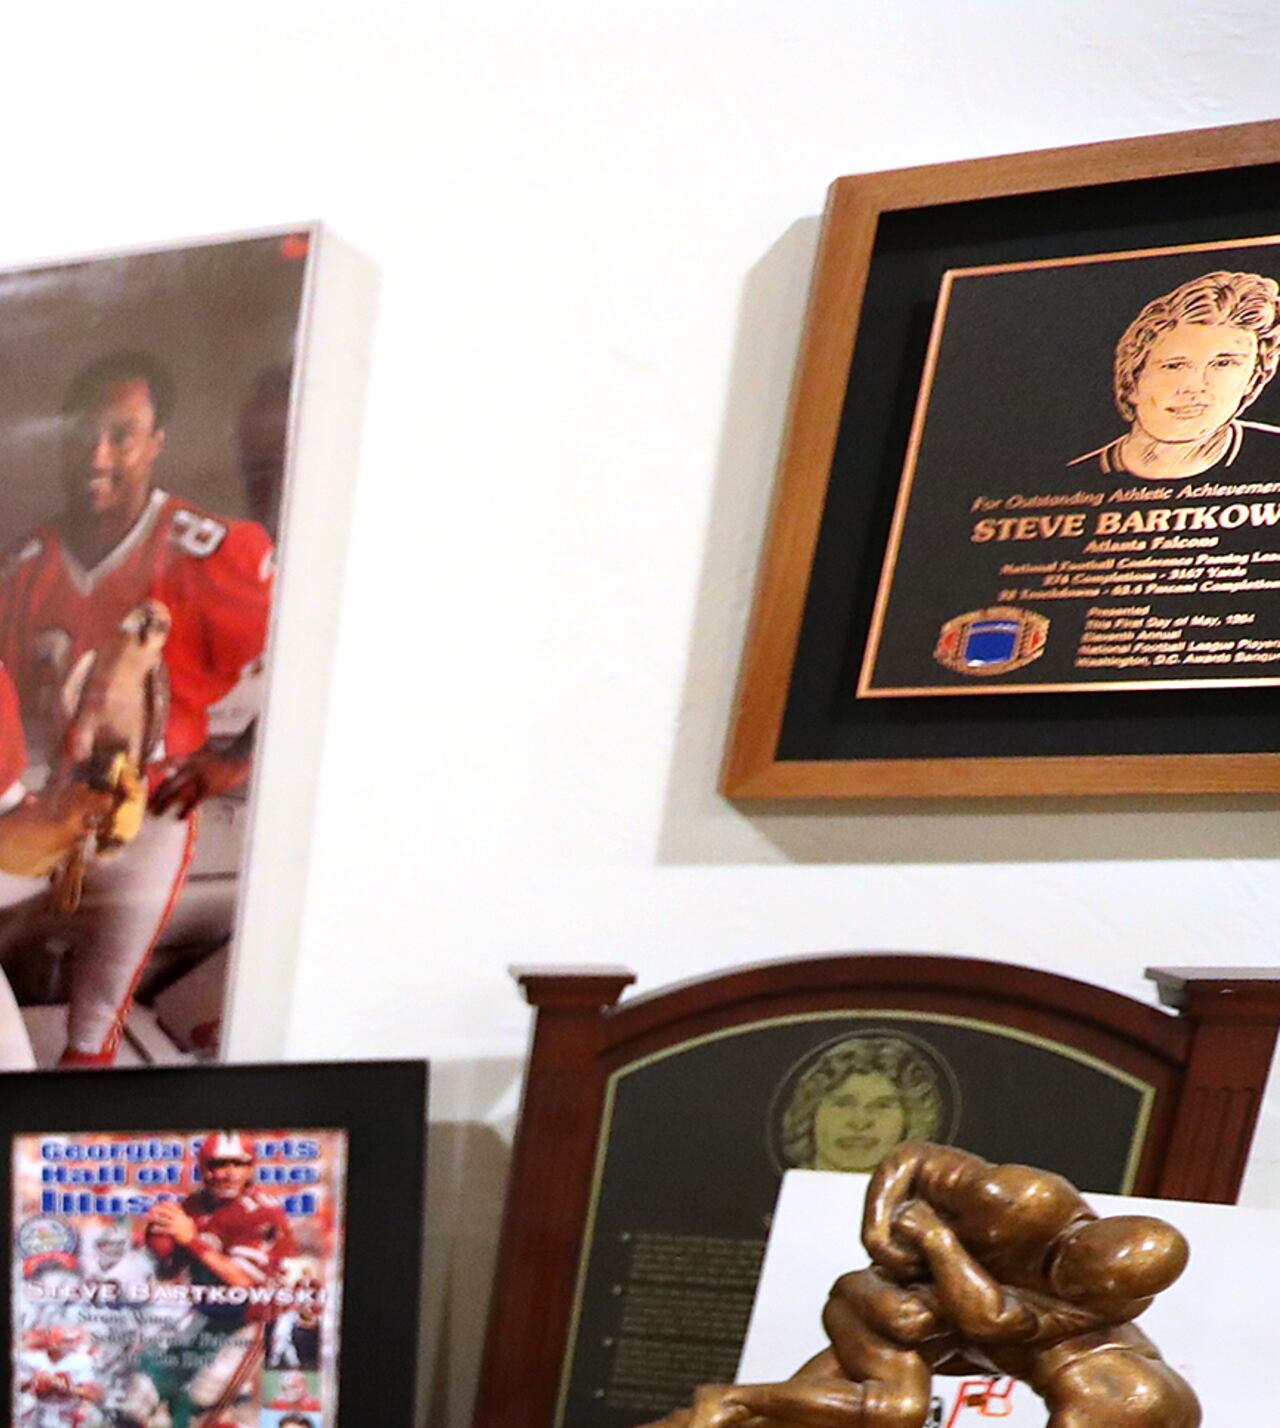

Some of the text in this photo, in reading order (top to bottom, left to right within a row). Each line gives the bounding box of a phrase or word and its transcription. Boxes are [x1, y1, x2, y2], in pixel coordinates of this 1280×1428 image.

[1005, 491, 1104, 509] Outstanding
[1108, 487, 1172, 502] Athletic
[970, 502, 1280, 543] STEVE BARTKOW
[1082, 535, 1219, 554] Atlanta Falcons
[1057, 558, 1115, 572] Football
[1070, 571, 1157, 586] Completions
[1146, 616, 1171, 630] Day
[1173, 616, 1188, 627] of
[1189, 614, 1221, 629] May,
[1131, 641, 1186, 654] Football
[1186, 640, 1236, 655] League
[1183, 652, 1231, 665] Awards
[41, 1140, 183, 1162] Georgia
[41, 1165, 126, 1184] Hall
[137, 1165, 183, 1184] of
[24, 1283, 328, 1305] STEVE BARTKOWSKI
